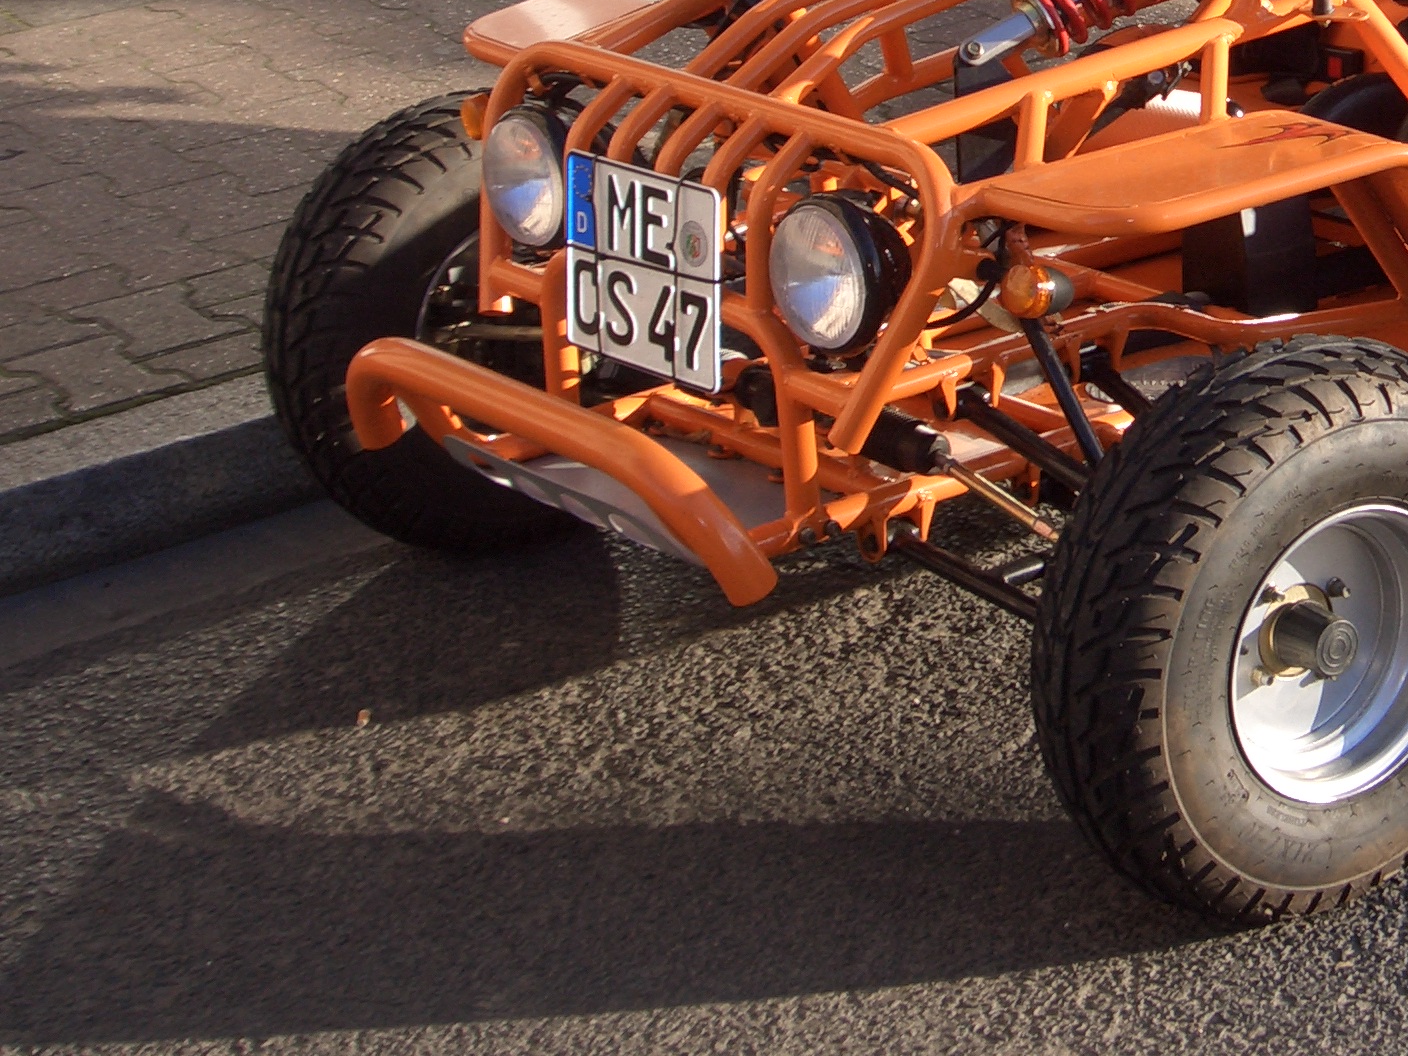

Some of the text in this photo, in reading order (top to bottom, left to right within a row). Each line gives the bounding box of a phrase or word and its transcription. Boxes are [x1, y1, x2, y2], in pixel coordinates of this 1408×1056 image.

[577, 211, 588, 233] D
[608, 174, 674, 270] ME
[574, 259, 712, 371] CS 47
